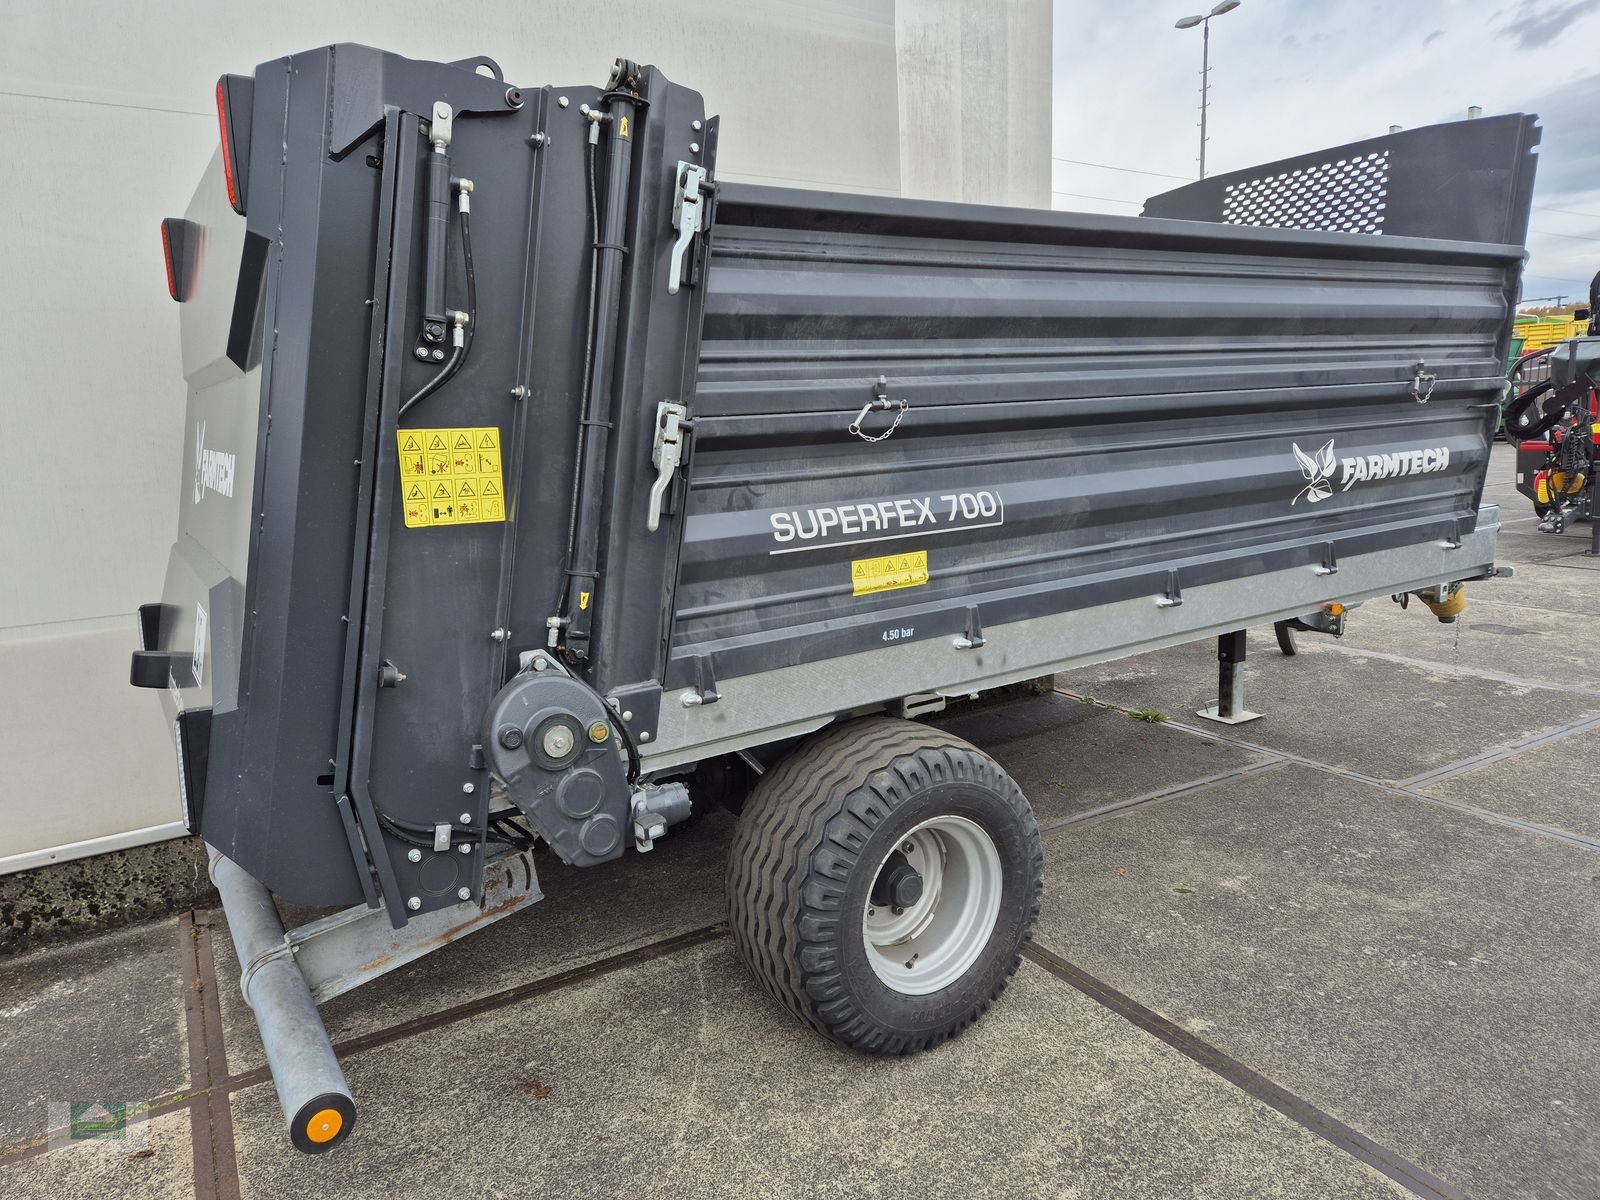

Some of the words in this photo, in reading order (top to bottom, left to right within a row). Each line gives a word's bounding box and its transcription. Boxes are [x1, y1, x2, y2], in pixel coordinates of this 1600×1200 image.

[1340, 447, 1450, 492] FARMTECH
[770, 497, 937, 542] SUPERFEX
[940, 491, 997, 522] 700
[882, 629, 900, 641] 4.50
[901, 627, 914, 638] bar
